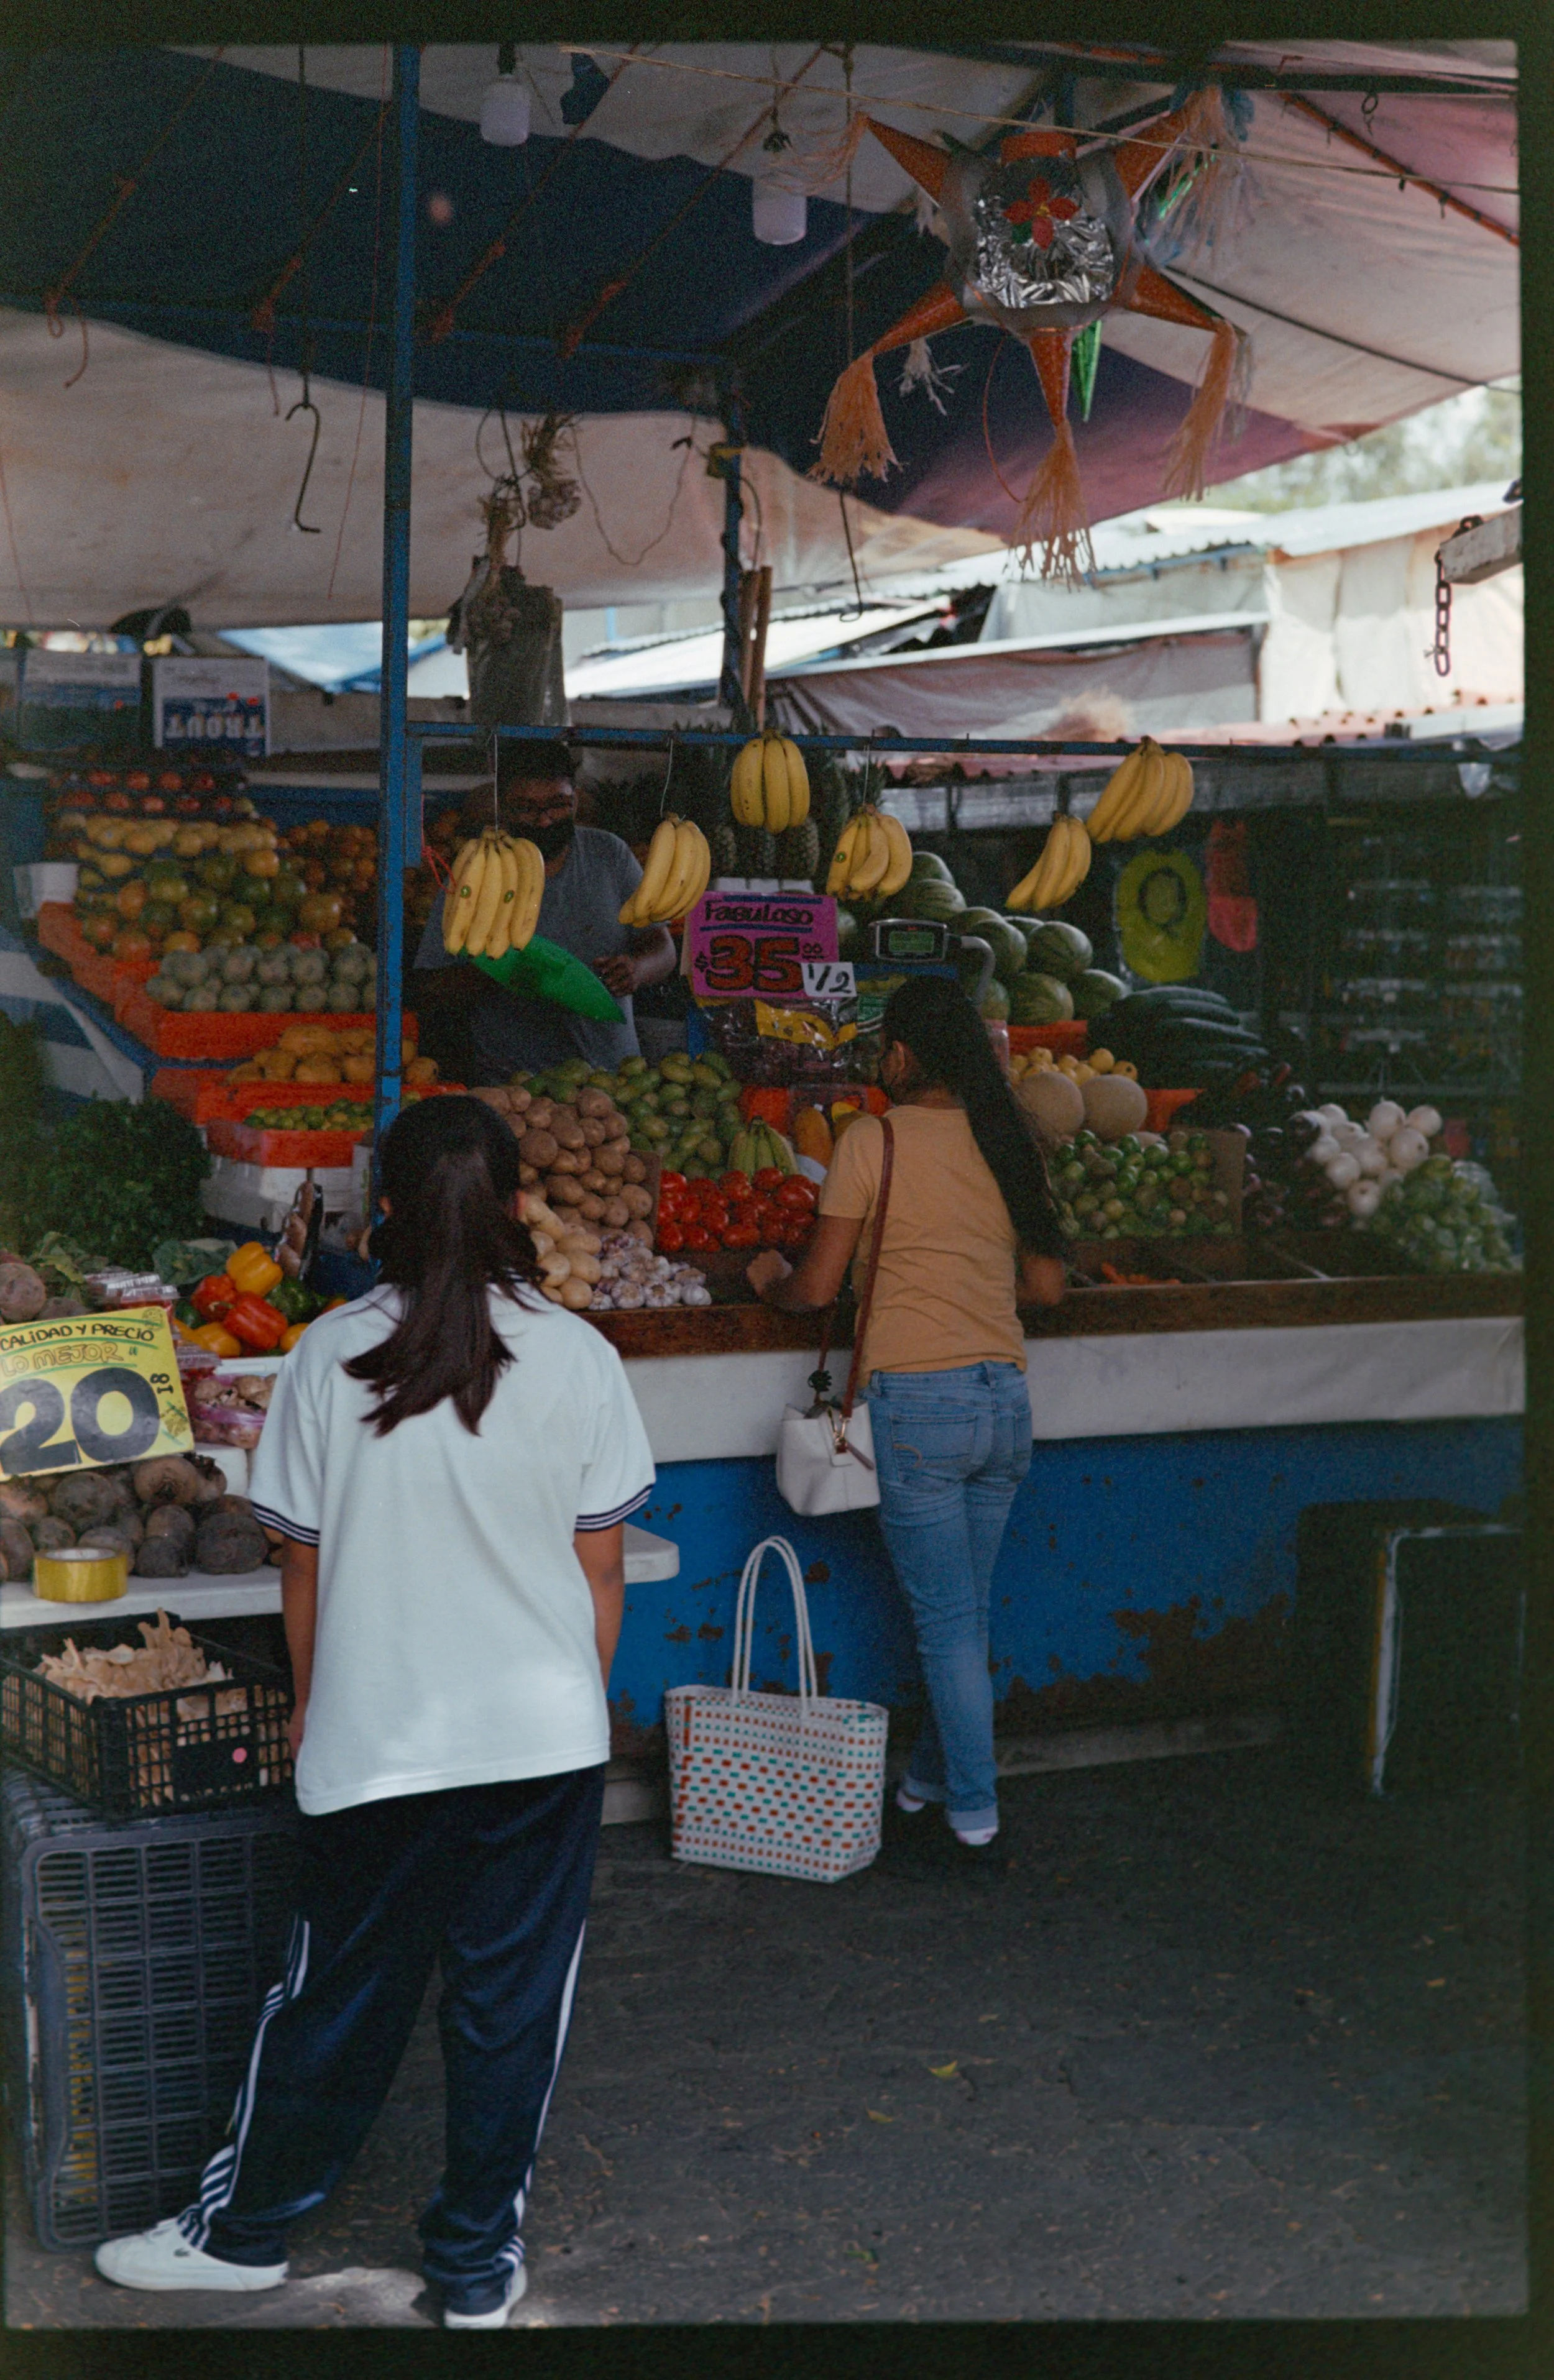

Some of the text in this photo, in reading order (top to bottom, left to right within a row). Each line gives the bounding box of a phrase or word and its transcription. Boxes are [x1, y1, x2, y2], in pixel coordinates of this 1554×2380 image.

[165, 714, 264, 739] TROUT
[76, 1324, 86, 1335] Y
[2, 1342, 124, 1377] LO MEJOR
[0, 1367, 160, 1475] 20
